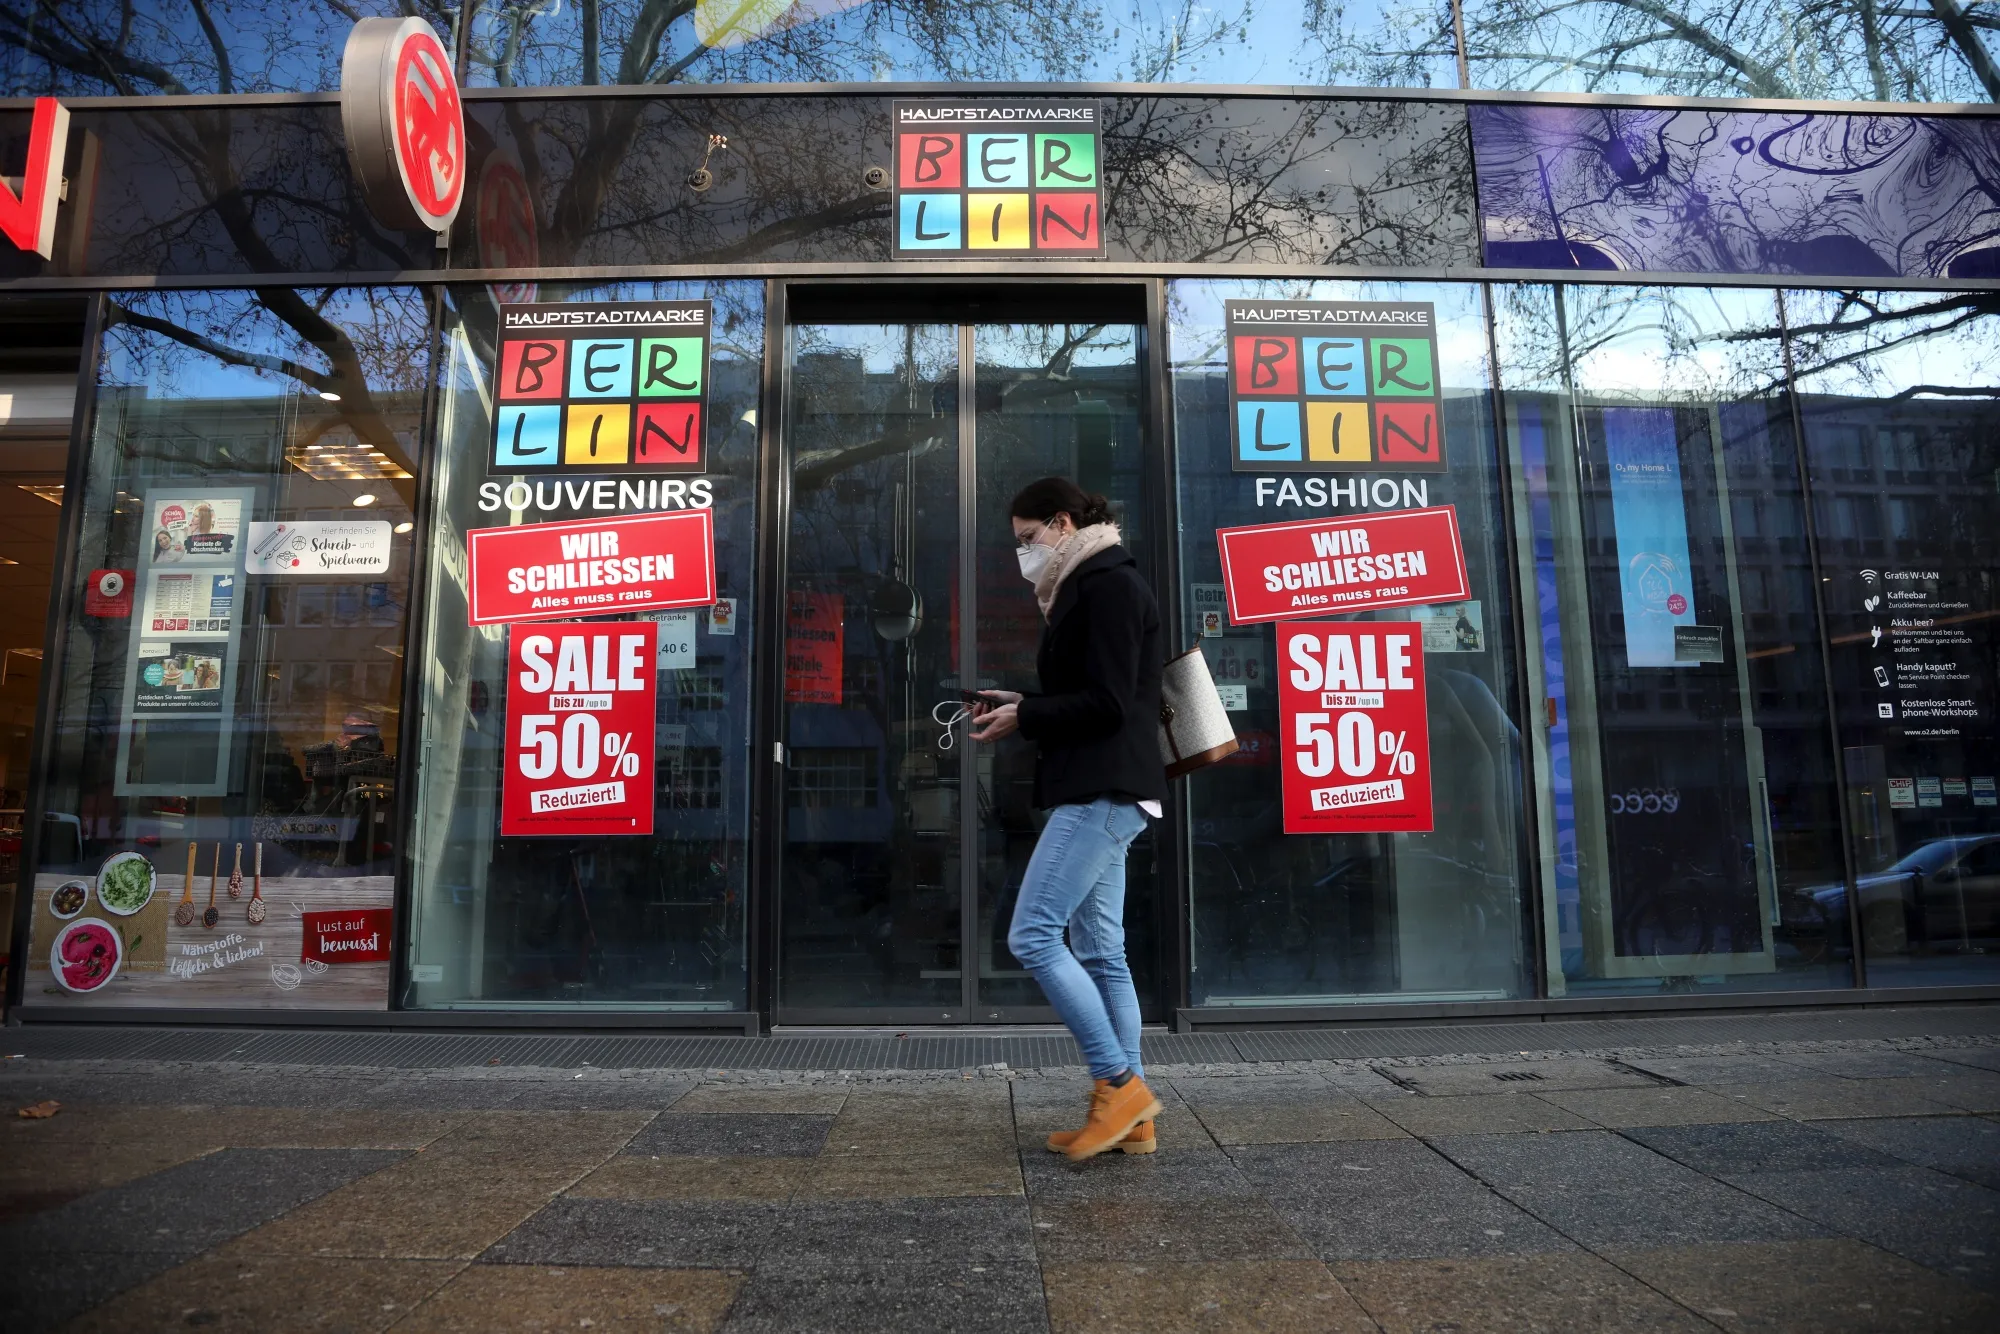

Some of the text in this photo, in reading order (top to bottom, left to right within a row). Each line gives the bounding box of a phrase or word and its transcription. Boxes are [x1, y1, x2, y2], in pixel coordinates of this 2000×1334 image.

[900, 108, 1094, 120] HAUPTSTADTMARKE
[505, 309, 705, 325] HAUPTSTADTMARKE
[1232, 308, 1428, 323] HAUPTSTADTMARKE
[1627, 464, 1640, 473] my
[1641, 463, 1665, 472] Home
[477, 479, 713, 512] SOUVENIRS
[1255, 477, 1429, 508] FASHION
[321, 526, 377, 535] Hier finden Sie
[310, 537, 375, 553] Schreib- und
[560, 531, 619, 561] WIR
[1310, 528, 1371, 558] WIR
[318, 552, 382, 569] Spielwaren
[508, 554, 675, 594] SCHLIESSEN
[1263, 550, 1428, 593] SCHLIESSEN
[1884, 571, 1939, 580] Gratis W-LAN
[531, 589, 653, 609] Alles muss raus
[1195, 588, 1227, 602] Getr
[1291, 585, 1409, 607] Alles muss raus
[1887, 591, 1927, 600] Kaffeebar
[1888, 601, 1928, 609] Zurücklehnen
[1940, 601, 1969, 609] Genießen
[1891, 618, 1934, 627] Akku leer?
[658, 643, 688, 656] ,40 €
[1936, 638, 1950, 646] ganz
[519, 634, 645, 694] SALE
[1206, 658, 1241, 681] ,40
[1288, 633, 1414, 692] SALE
[1896, 663, 1956, 672] Handy kaputt?
[553, 696, 570, 708] bis
[572, 697, 585, 708] zu
[600, 699, 607, 707] to
[1326, 694, 1343, 705] bis
[1344, 695, 1357, 706] zu
[1372, 697, 1379, 705] to
[1901, 699, 1975, 708] Kostenlose Smart-
[1902, 708, 1978, 718] phone-Workshops
[1904, 728, 1959, 736] www.o2.de/berlin
[519, 712, 640, 779] 50%
[1295, 711, 1416, 778] 50%
[1889, 780, 1912, 788] CHIP
[540, 786, 617, 809] Reduziert!
[1319, 784, 1396, 807] Reduziert!
[317, 918, 365, 933] Lust auf
[182, 933, 247, 956] Nährstoffe.
[321, 931, 381, 954] bewusst
[170, 940, 264, 979] Löffeln & lieben!
